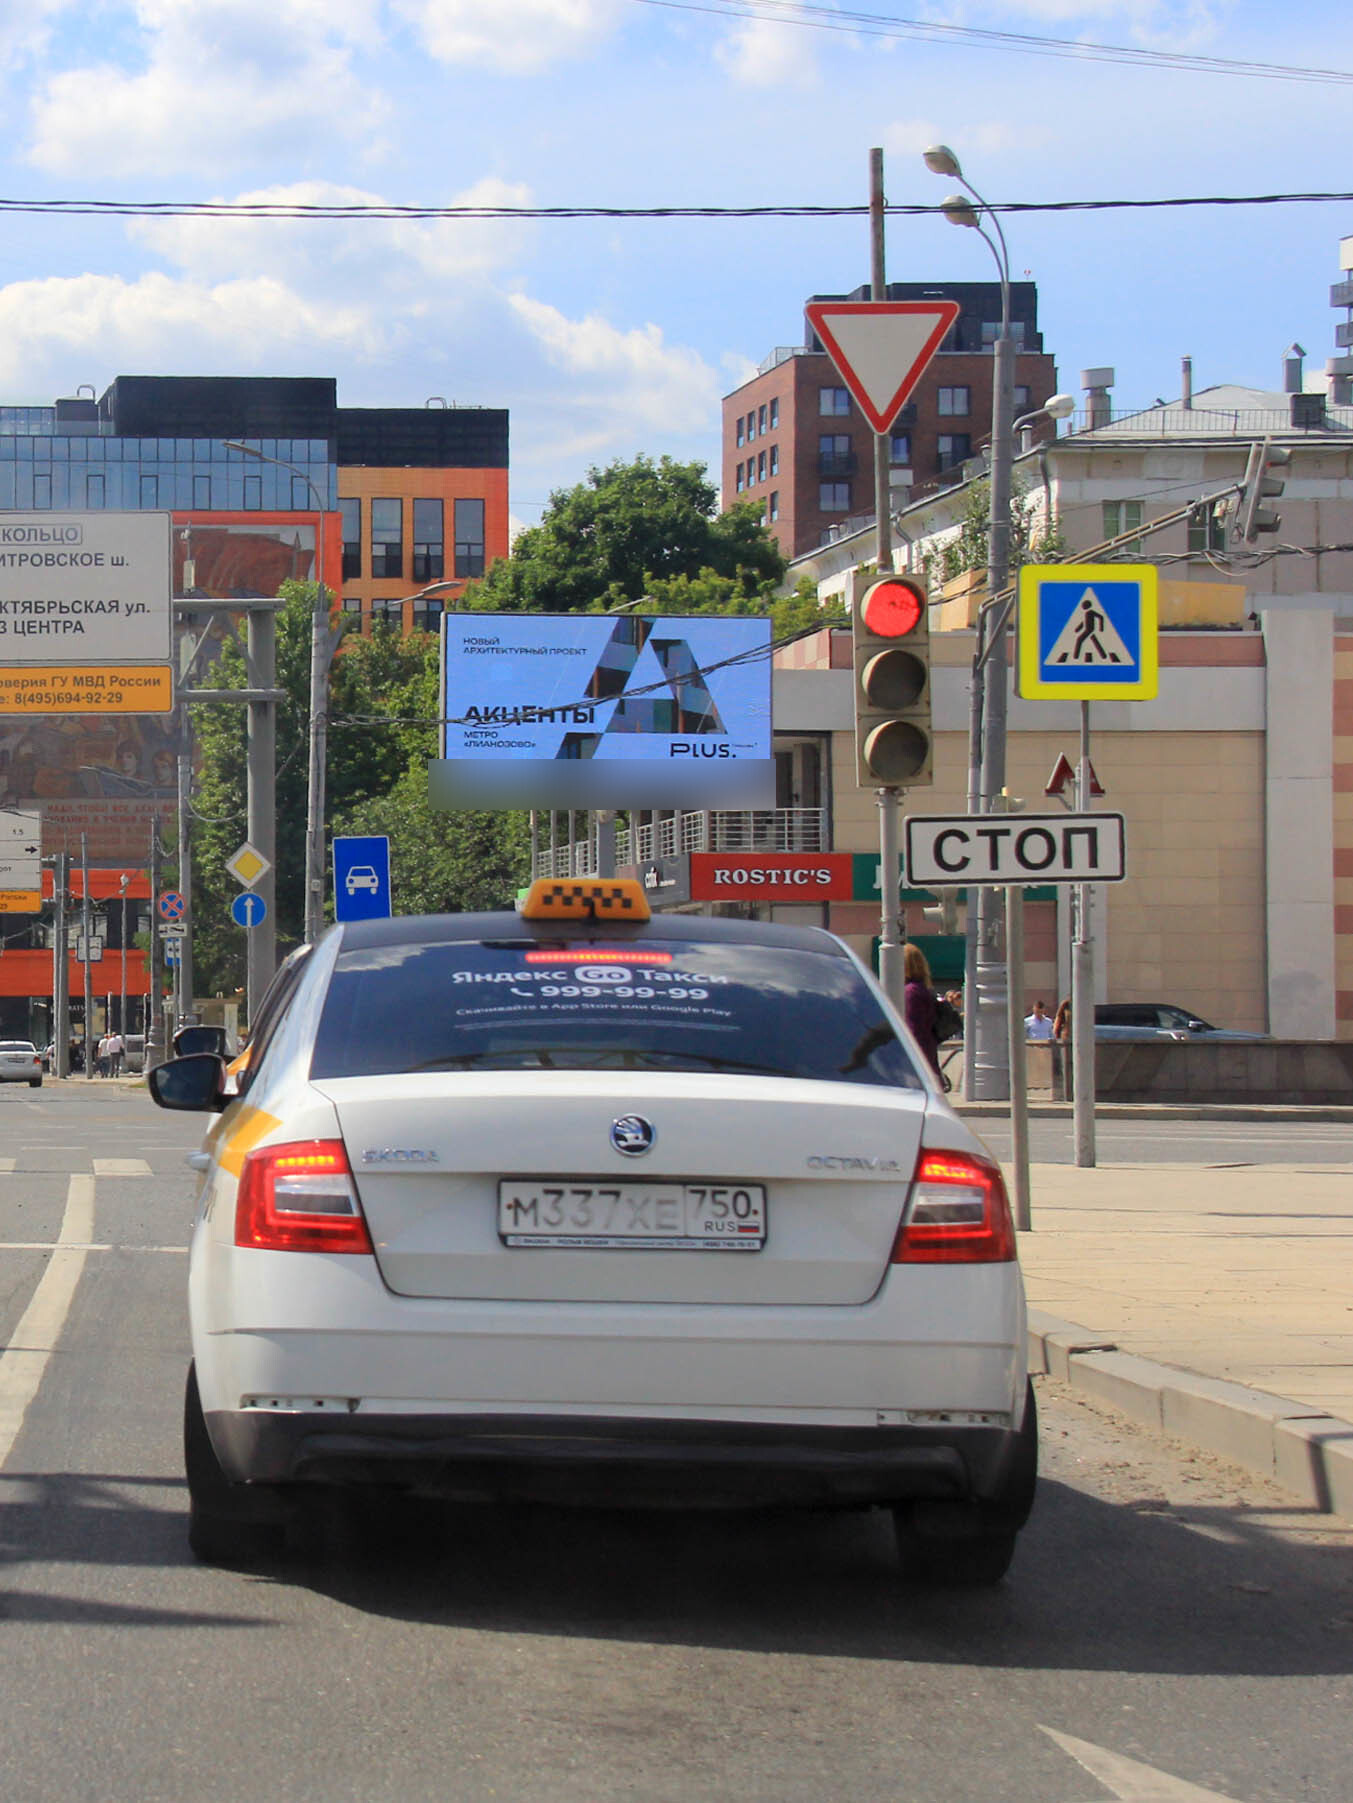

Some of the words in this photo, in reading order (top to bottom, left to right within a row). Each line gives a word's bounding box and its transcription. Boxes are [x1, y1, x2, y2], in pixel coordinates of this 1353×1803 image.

[1, 528, 79, 545] КОЛЬЦО
[110, 555, 129, 567] ш.
[124, 602, 151, 617] ул.
[13, 620, 85, 638] ЦЕНТРА
[463, 636, 500, 646] НОВЫЙ
[463, 646, 548, 656] АРХИТЕКТУРНЫЙ
[548, 648, 587, 657] ПРОЕКТ
[50, 676, 69, 688] ГУ
[72, 675, 106, 689] МВД
[110, 675, 161, 688] России
[14, 691, 124, 706] 8(495)694-92-29
[464, 705, 595, 728] АКЦЕНТЫ
[463, 731, 499, 740] МЕТРО
[463, 740, 537, 749] «ЛИАНОЗОВО»
[932, 826, 1100, 873] СТОП
[714, 868, 832, 885] ROSTIC'S
[452, 970, 568, 984] Яндекс
[636, 969, 729, 985] Такси
[540, 985, 709, 1000] 999-99-99
[688, 1188, 751, 1219] 750
[704, 1220, 736, 1232] RUS
